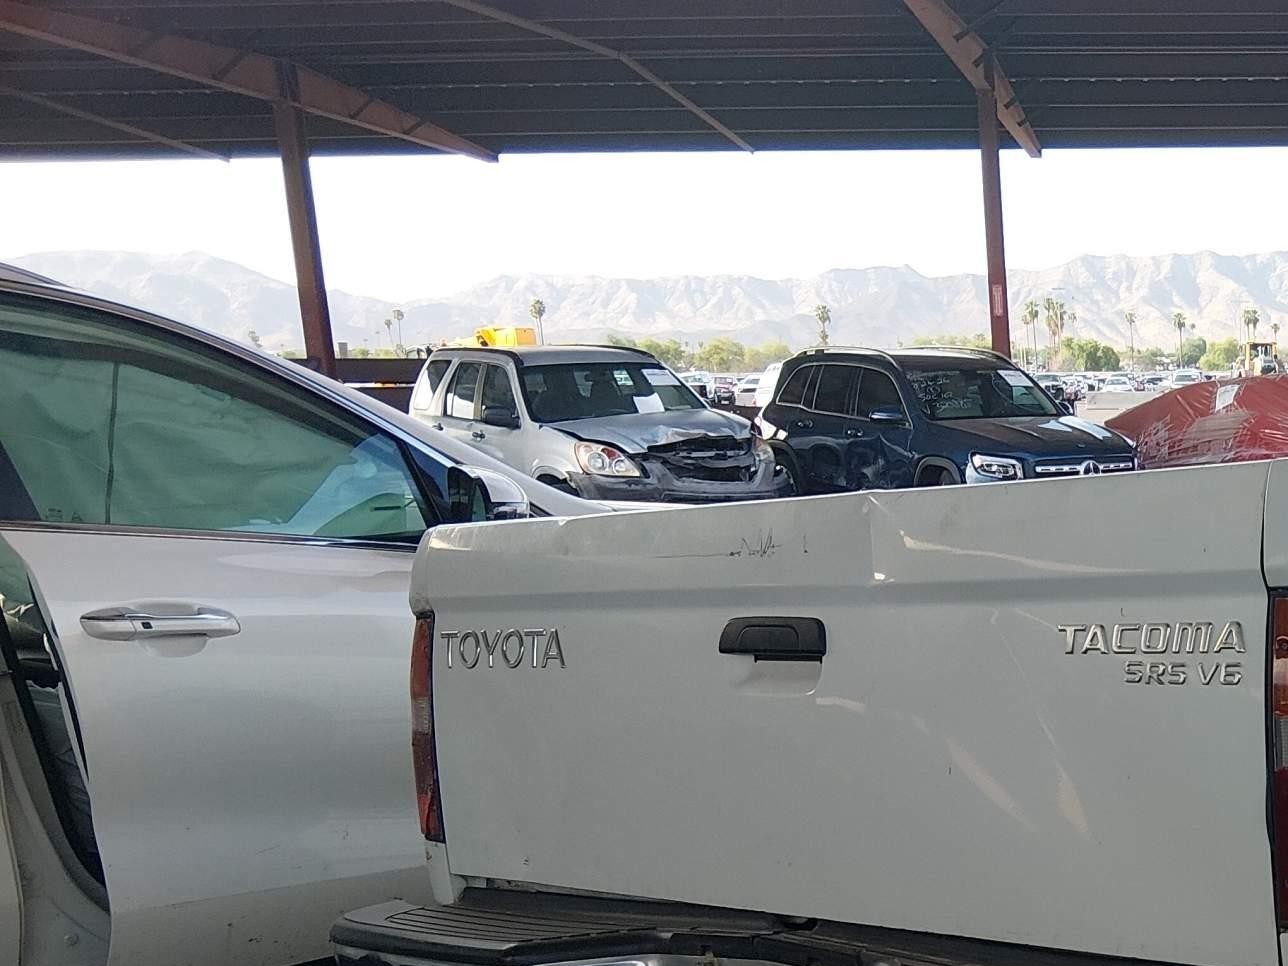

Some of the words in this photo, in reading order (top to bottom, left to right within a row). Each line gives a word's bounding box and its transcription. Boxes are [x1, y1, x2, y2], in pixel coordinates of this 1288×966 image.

[440, 628, 567, 669] TOYOTA
[1057, 621, 1247, 655] TACOMA
[1197, 662, 1243, 686] V6
